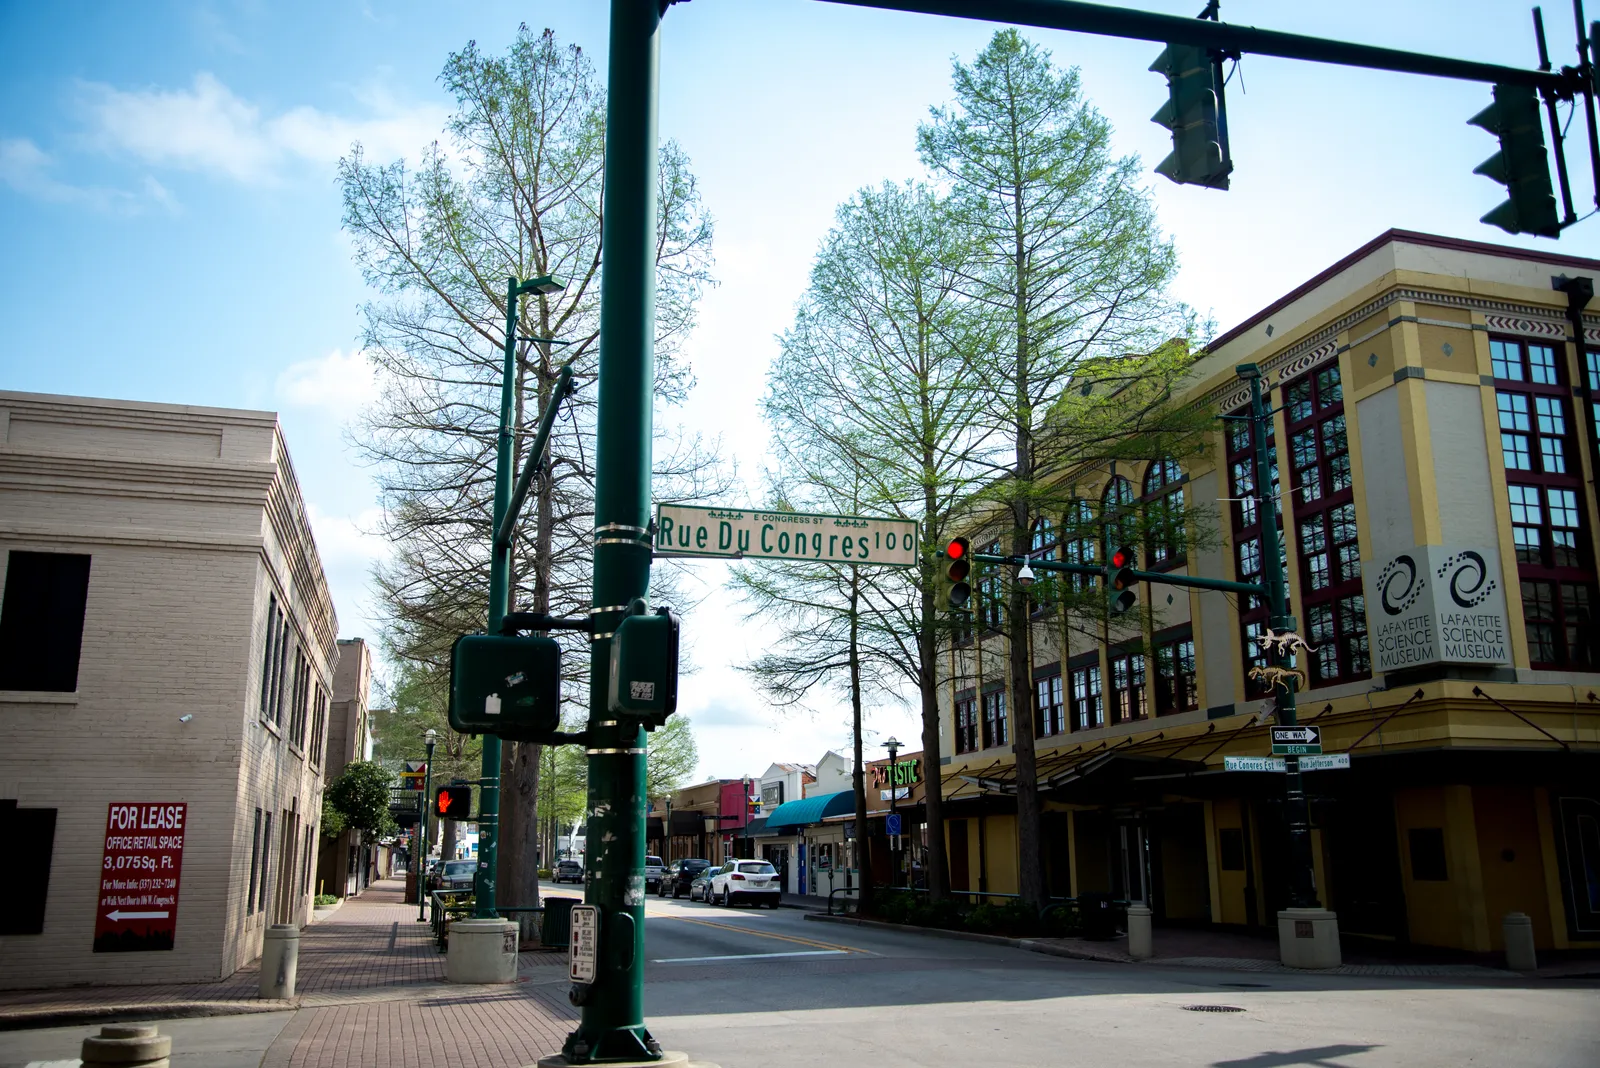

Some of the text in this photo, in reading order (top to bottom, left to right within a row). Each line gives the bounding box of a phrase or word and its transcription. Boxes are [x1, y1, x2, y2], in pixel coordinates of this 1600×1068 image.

[753, 513, 824, 525] E CONGRESS ST
[660, 516, 914, 559] Rue Du Congres 100
[1377, 614, 1430, 637] LAFAYETTE
[1440, 613, 1502, 628] LAFAYETTE
[1378, 628, 1433, 653] SCIENCE
[1442, 627, 1504, 644] SCIENCE
[1380, 645, 1434, 668] MUSEUM
[1445, 644, 1506, 660] MUSEUM
[1275, 731, 1307, 740] ONE WAY
[1287, 746, 1307, 754] BEGIN
[1225, 760, 1237, 770] Rue
[1238, 760, 1263, 771] Congres
[1264, 761, 1275, 771] Est
[1300, 761, 1309, 769] Rue
[1310, 760, 1334, 768] Jefferson
[110, 806, 184, 829] FOR LEASE
[107, 836, 182, 849] OFFICE/RETAIL SPACE
[161, 855, 174, 869] Ft.
[103, 879, 112, 889] For
[113, 879, 126, 890] More
